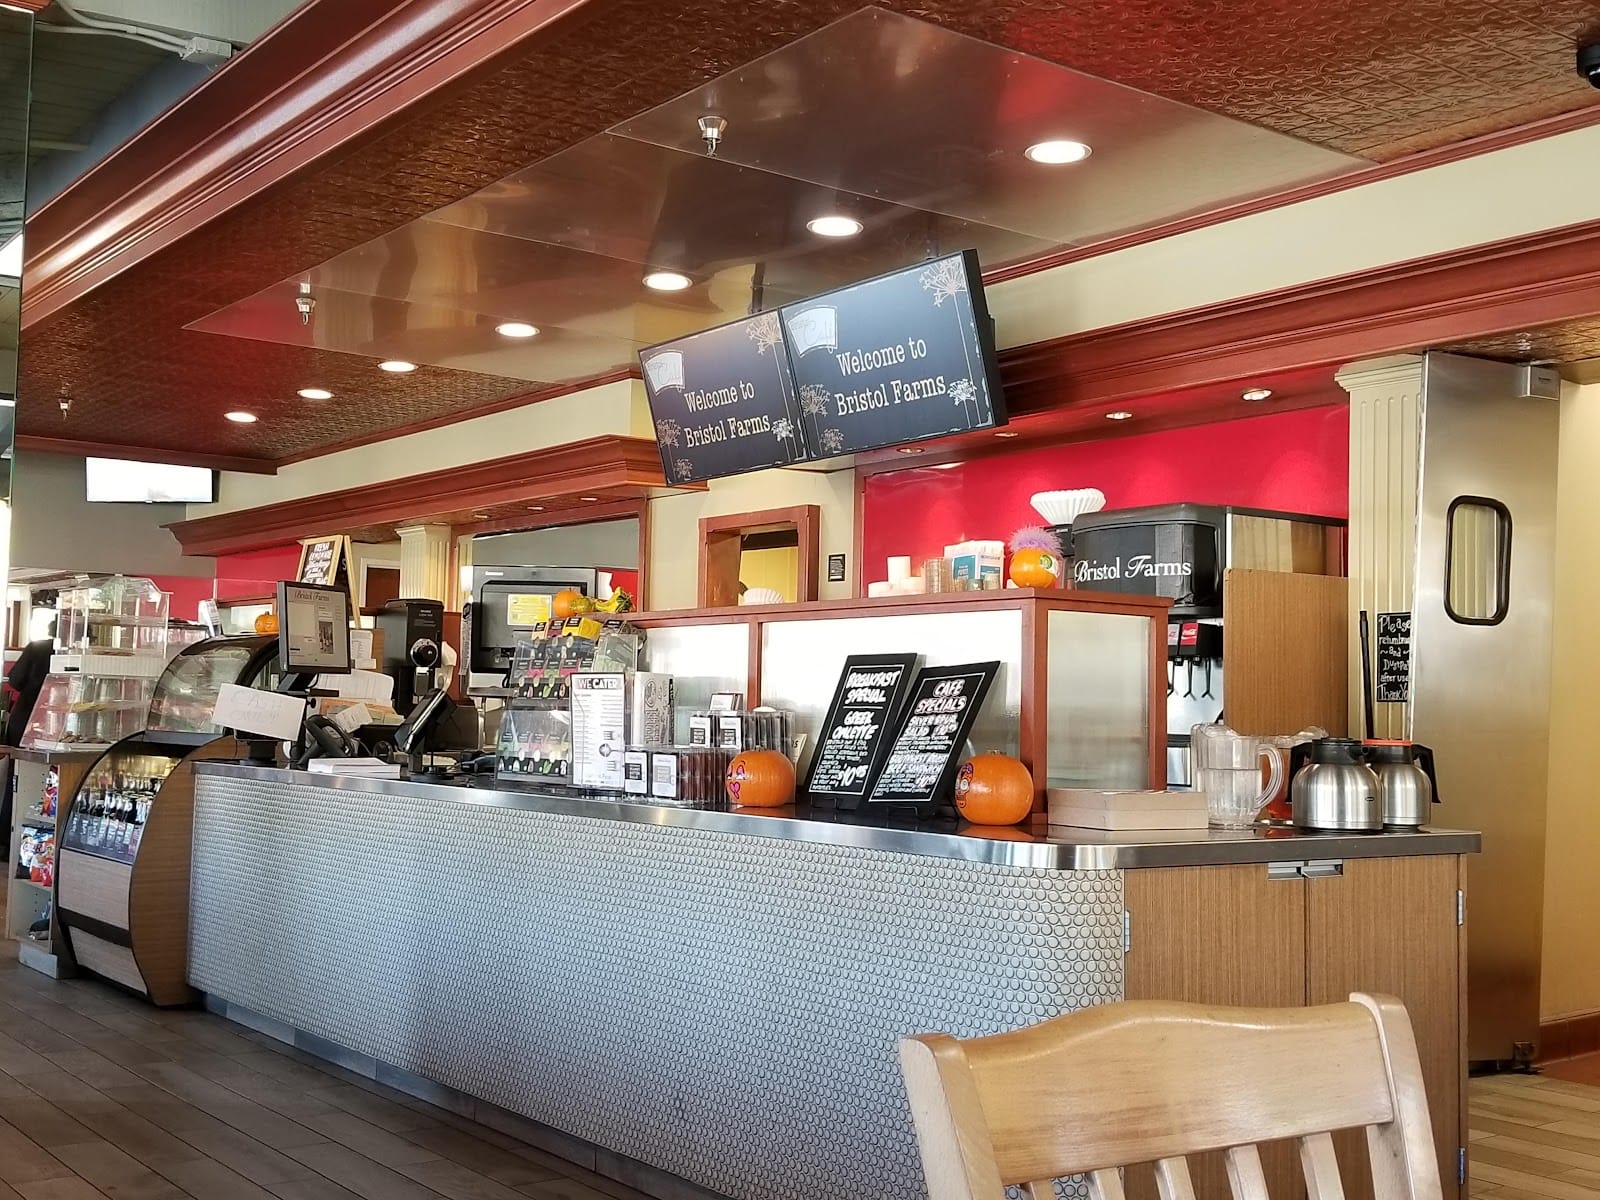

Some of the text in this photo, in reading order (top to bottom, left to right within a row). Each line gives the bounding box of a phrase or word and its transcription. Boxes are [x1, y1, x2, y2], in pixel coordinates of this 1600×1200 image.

[836, 337, 928, 377] Welcome to
[683, 380, 755, 413] Welcome to
[834, 374, 947, 416] Bristol Farms
[683, 413, 772, 449] Bristol Farms
[1074, 555, 1192, 583] Bristol Farms
[1378, 615, 1411, 633] Please
[1383, 658, 1409, 671] Dustpa
[578, 678, 617, 689] WE CATER
[846, 670, 901, 689] BREAKFAST
[933, 679, 966, 698] CAFE
[844, 687, 887, 705] SPECIAL
[914, 695, 967, 714] SPECIALS
